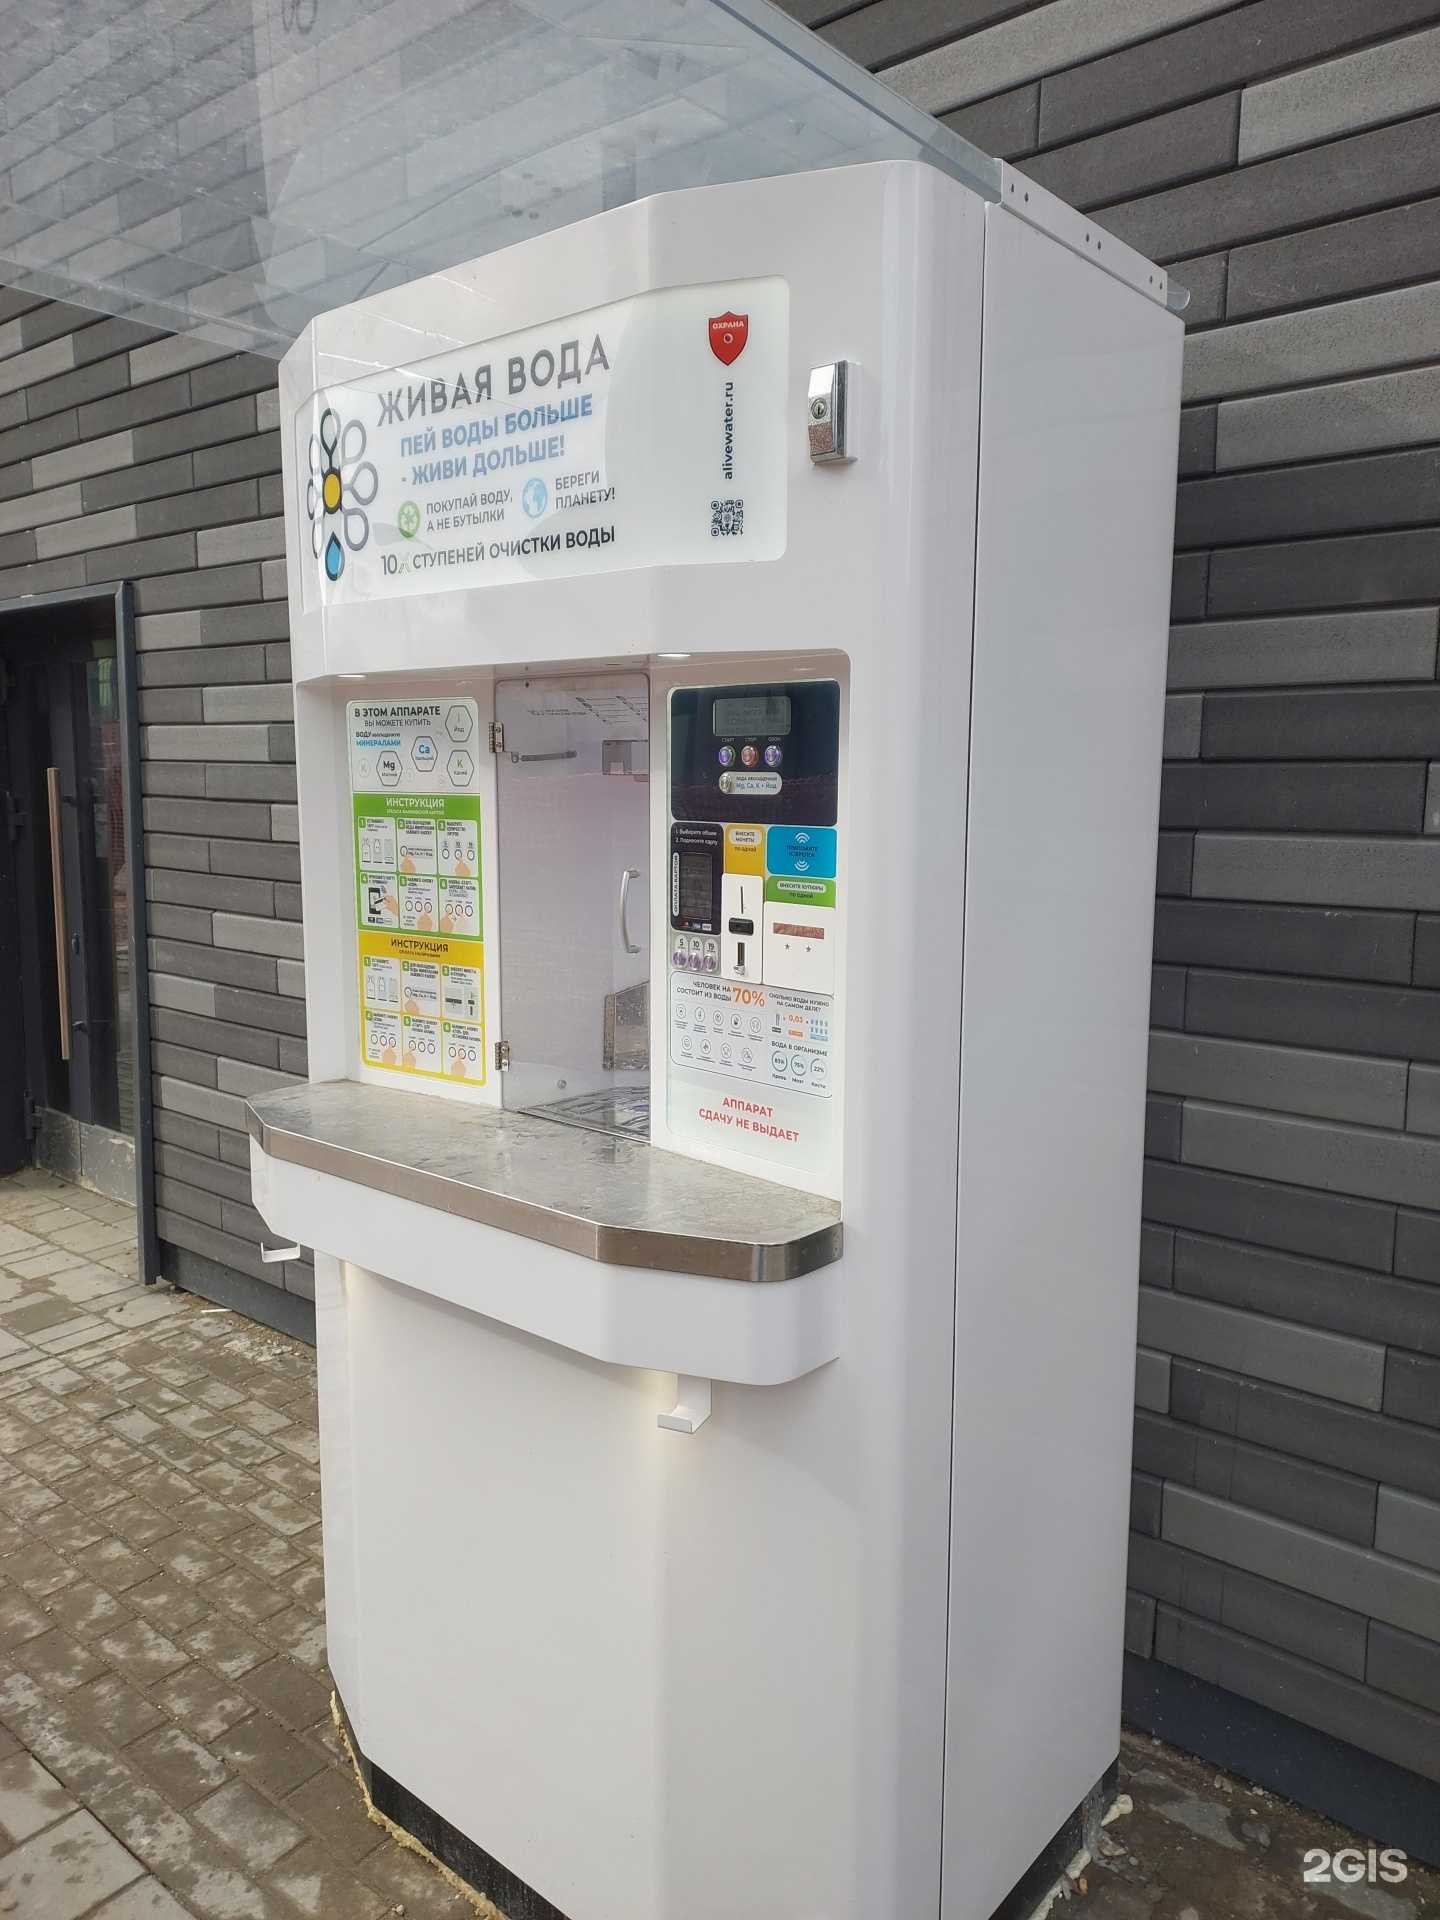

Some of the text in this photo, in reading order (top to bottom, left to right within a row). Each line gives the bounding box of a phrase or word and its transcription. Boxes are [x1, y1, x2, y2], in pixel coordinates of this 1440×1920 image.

[712, 320, 744, 329] ОХРАНА
[377, 333, 610, 426] ЖИВАЯ ВОДА
[400, 393, 593, 457] ПЕЙ ВОДЫ БОЛЬШЕ
[722, 382, 734, 480] alivewater.ru
[413, 456, 467, 485] ЖИВИ
[472, 435, 565, 477] ДОЛЬШЕ!
[555, 470, 600, 490] БЕРЕГИ
[426, 489, 513, 515] ПОКУПАЙ ВОДУ,
[555, 487, 616, 509] ПЛАНЕТУ!
[427, 508, 505, 532] А НЕ БУТЫЛКИ
[413, 542, 485, 569] СТУПЕНЕЙ
[490, 534, 561, 559] ОЧИСТКИ
[566, 525, 615, 549] ВОДЫ
[354, 706, 441, 717] В ЭТОМ АППАРАТЕ
[375, 719, 403, 727] МОЖЕТЕ
[419, 745, 430, 754] Ca
[383, 761, 395, 771] Mg
[386, 797, 445, 808] ИНСТРУКЦИЯ
[391, 938, 449, 952] ИНСТРУКЦИЯ
[680, 938, 684, 946] 5
[676, 987, 703, 996] СОСТОИТ
[713, 993, 732, 1001] ВОДЫ
[693, 981, 720, 990] ЧЕЛОВЕК
[735, 987, 765, 1007] 70%
[771, 1041, 788, 1049] ВОДА
[722, 1097, 774, 1118] АППАРАТ
[699, 1108, 799, 1142] СДАЧУ НЕ ВЫДАЕТ
